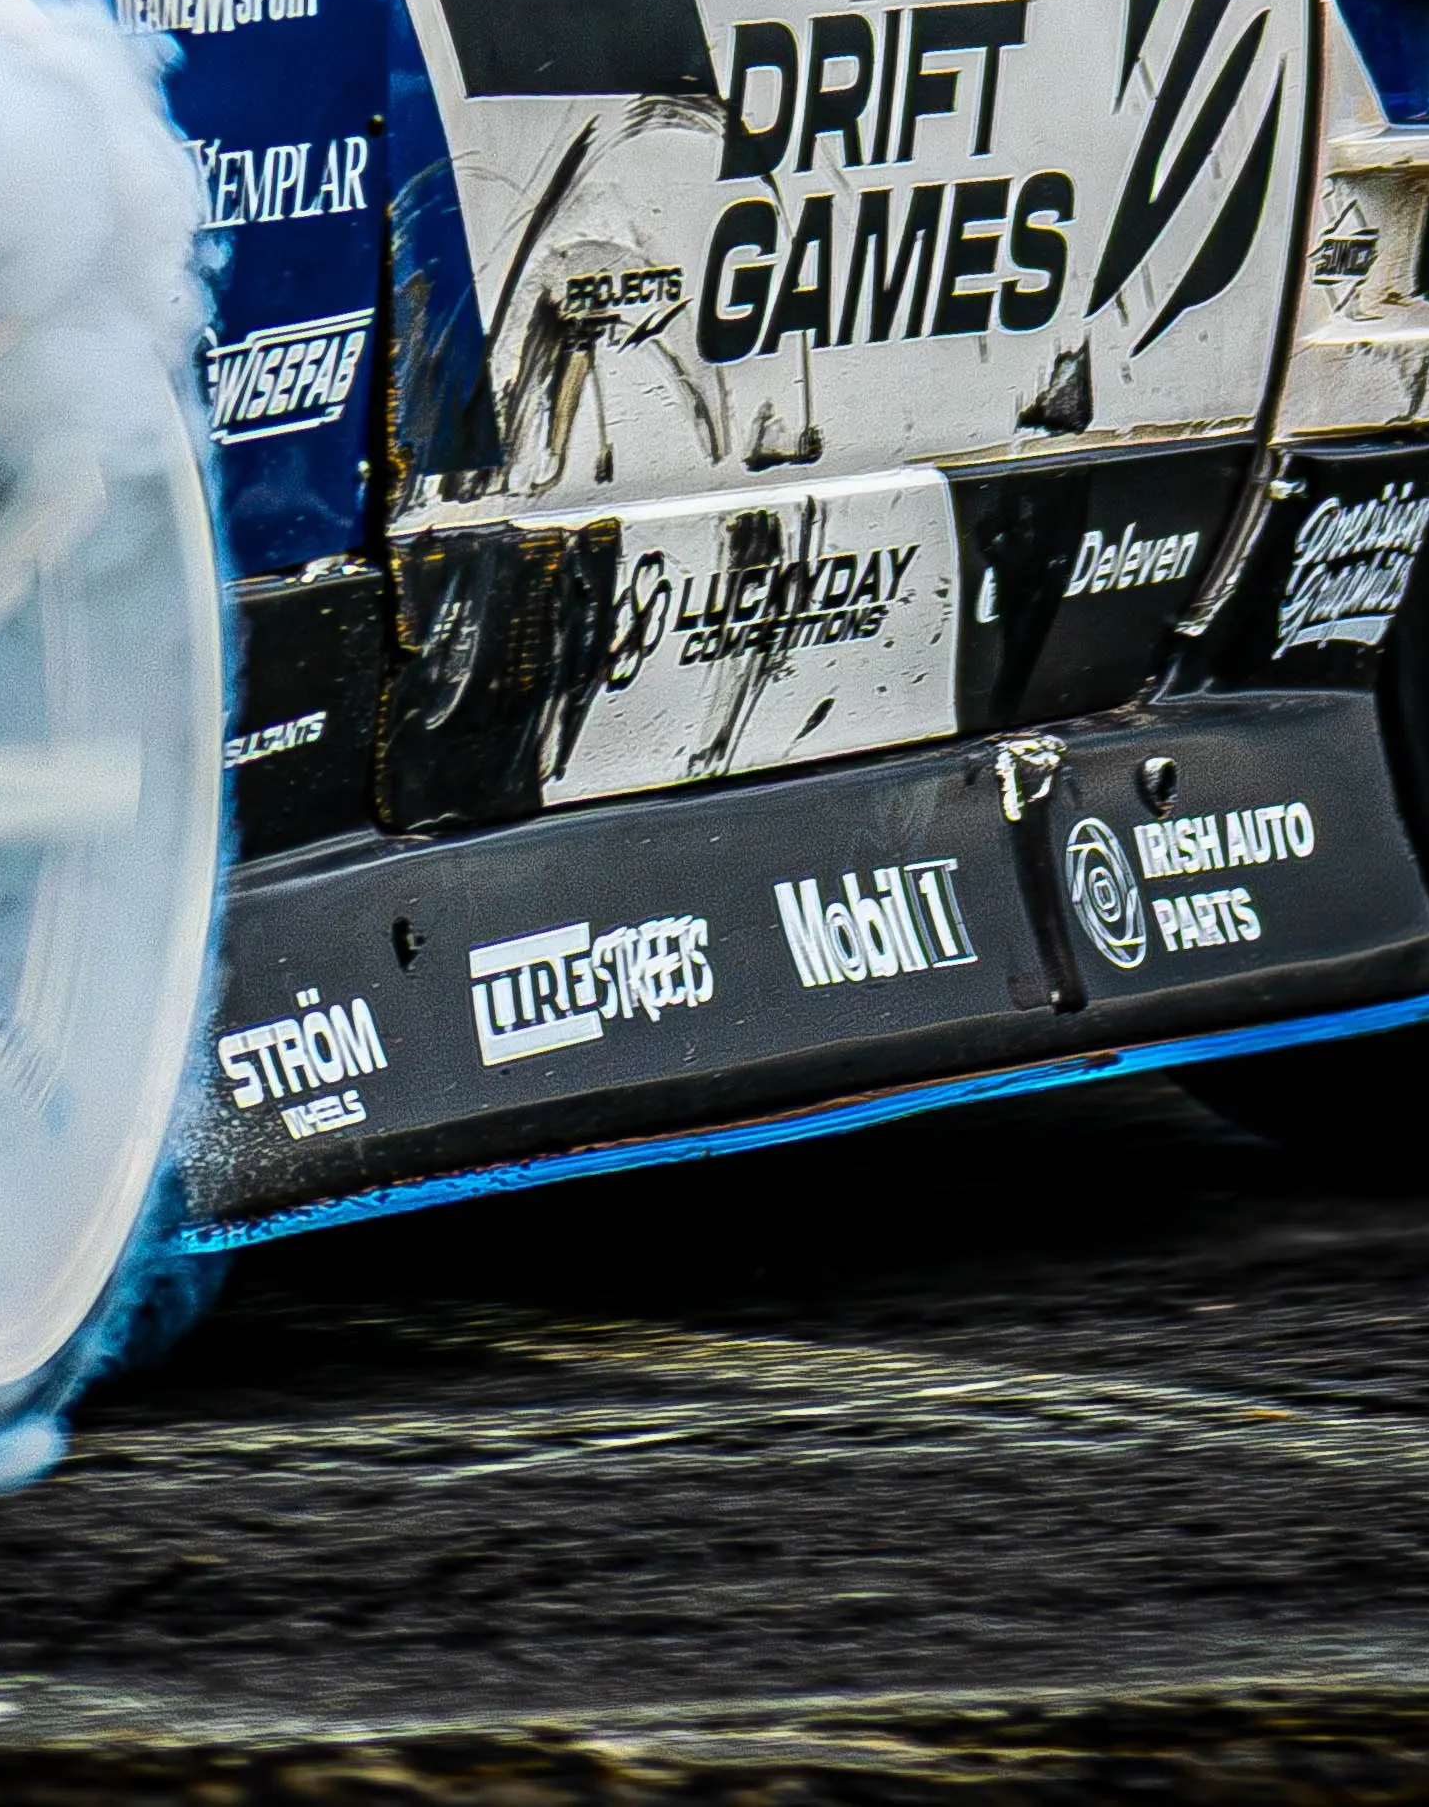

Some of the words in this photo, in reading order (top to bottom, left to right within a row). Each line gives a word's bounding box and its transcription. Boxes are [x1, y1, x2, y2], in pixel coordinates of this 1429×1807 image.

[563, 266, 685, 313] PROJECTS
[696, 169, 1076, 364] GAMES
[211, 330, 367, 429] WISEFAB
[1062, 522, 1200, 598] Deleven
[1134, 814, 1226, 879] IRISH
[1226, 802, 1315, 868] AUTO
[774, 866, 929, 988] Mobil
[1152, 887, 1262, 952] PARTS
[218, 987, 389, 1109] STRÖM
